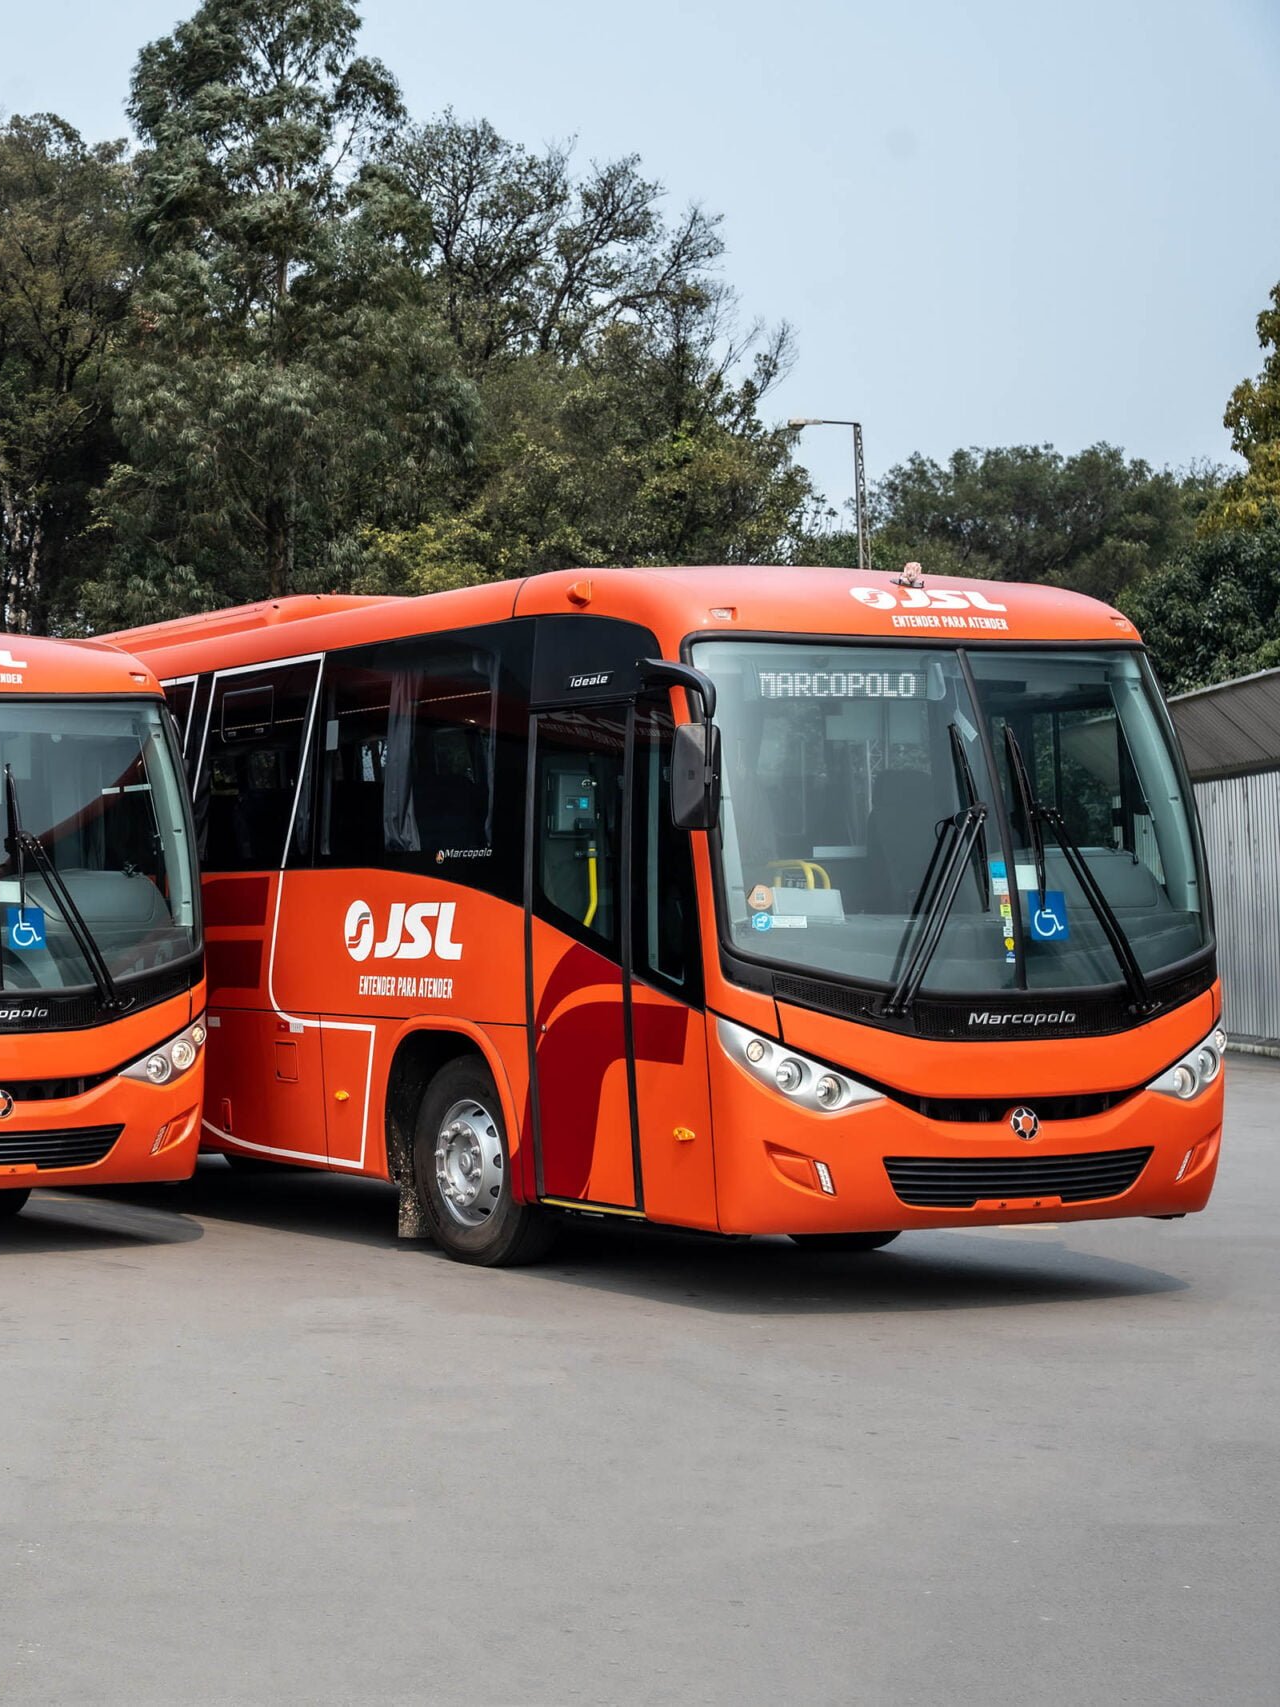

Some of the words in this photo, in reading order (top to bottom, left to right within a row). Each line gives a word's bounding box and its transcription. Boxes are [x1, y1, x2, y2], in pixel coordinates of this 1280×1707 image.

[900, 588, 1007, 612] JSL
[891, 615, 941, 628] ENTENDER
[941, 616, 966, 629] PARA
[968, 617, 1009, 631] ATENDER
[570, 674, 609, 688] Ideale
[758, 672, 916, 698] MARCOPOLO
[444, 848, 493, 860] Marcopolo
[373, 901, 464, 961] JSL
[358, 975, 396, 996] ENTENDER
[397, 976, 417, 997] PARA
[418, 977, 453, 999] ATENDER
[968, 1010, 1077, 1026] Marcopolo
